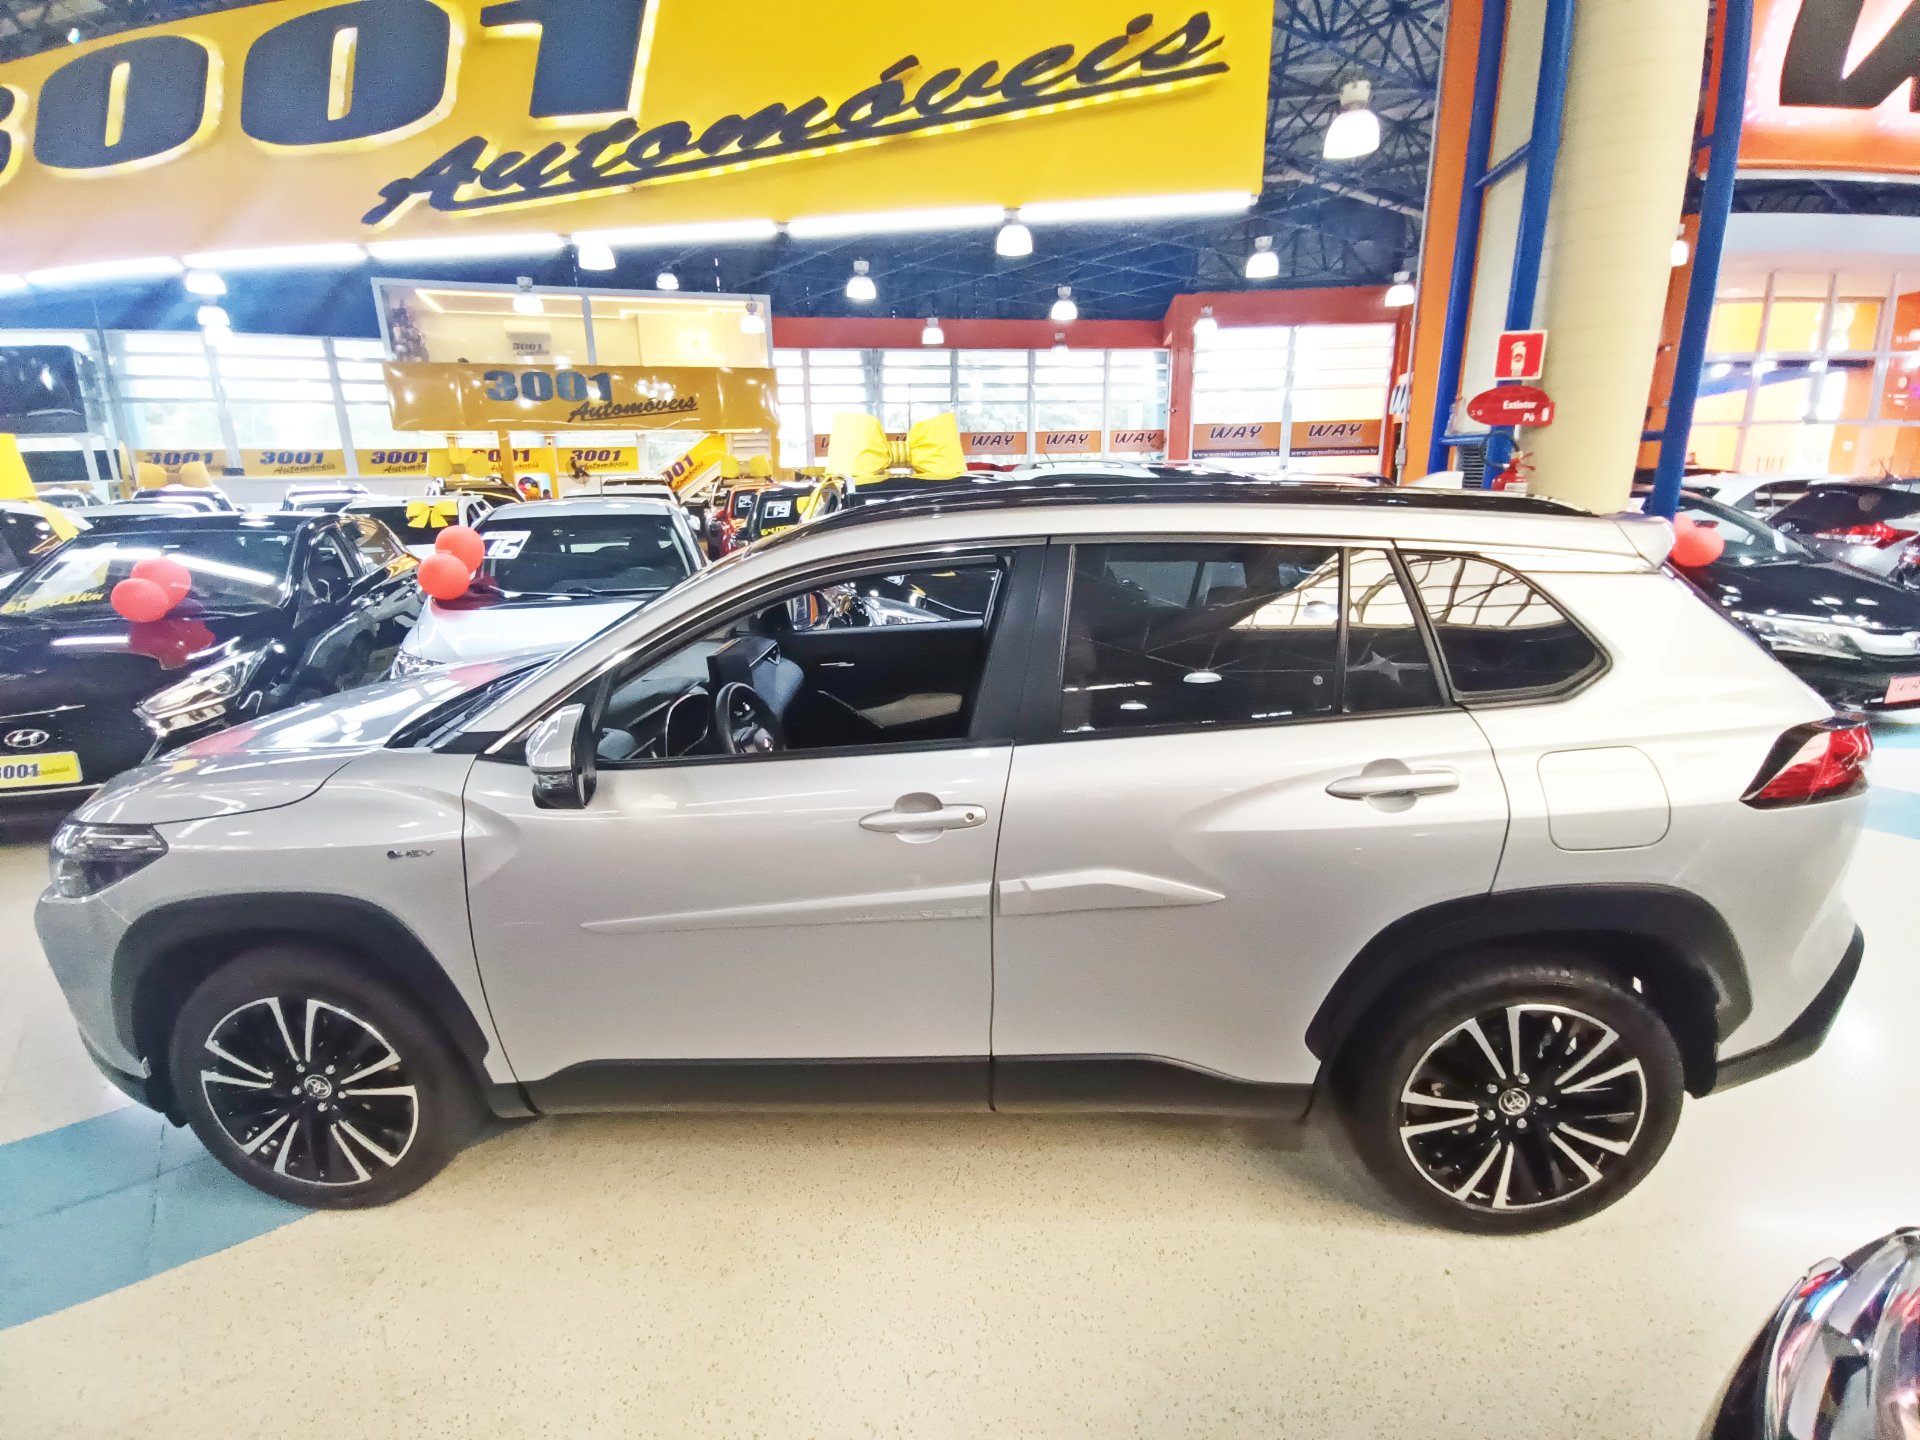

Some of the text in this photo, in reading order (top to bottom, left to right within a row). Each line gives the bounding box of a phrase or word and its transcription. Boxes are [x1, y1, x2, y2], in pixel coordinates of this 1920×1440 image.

[0, 0, 647, 174] 001
[361, 12, 1229, 226] Automóveis
[484, 370, 613, 402] 3001
[566, 395, 699, 423] Automóveis
[1502, 400, 1538, 410] Extintor
[1210, 425, 1262, 439] WAY
[1308, 423, 1362, 437] WAY
[972, 434, 1015, 446] WAY
[1046, 433, 1088, 445] WAY
[1115, 432, 1157, 444] WAY
[260, 451, 325, 464] 3001
[371, 450, 427, 464] 3001
[571, 449, 621, 462] 3001
[488, 539, 519, 557] 16
[0, 763, 39, 780] 001
